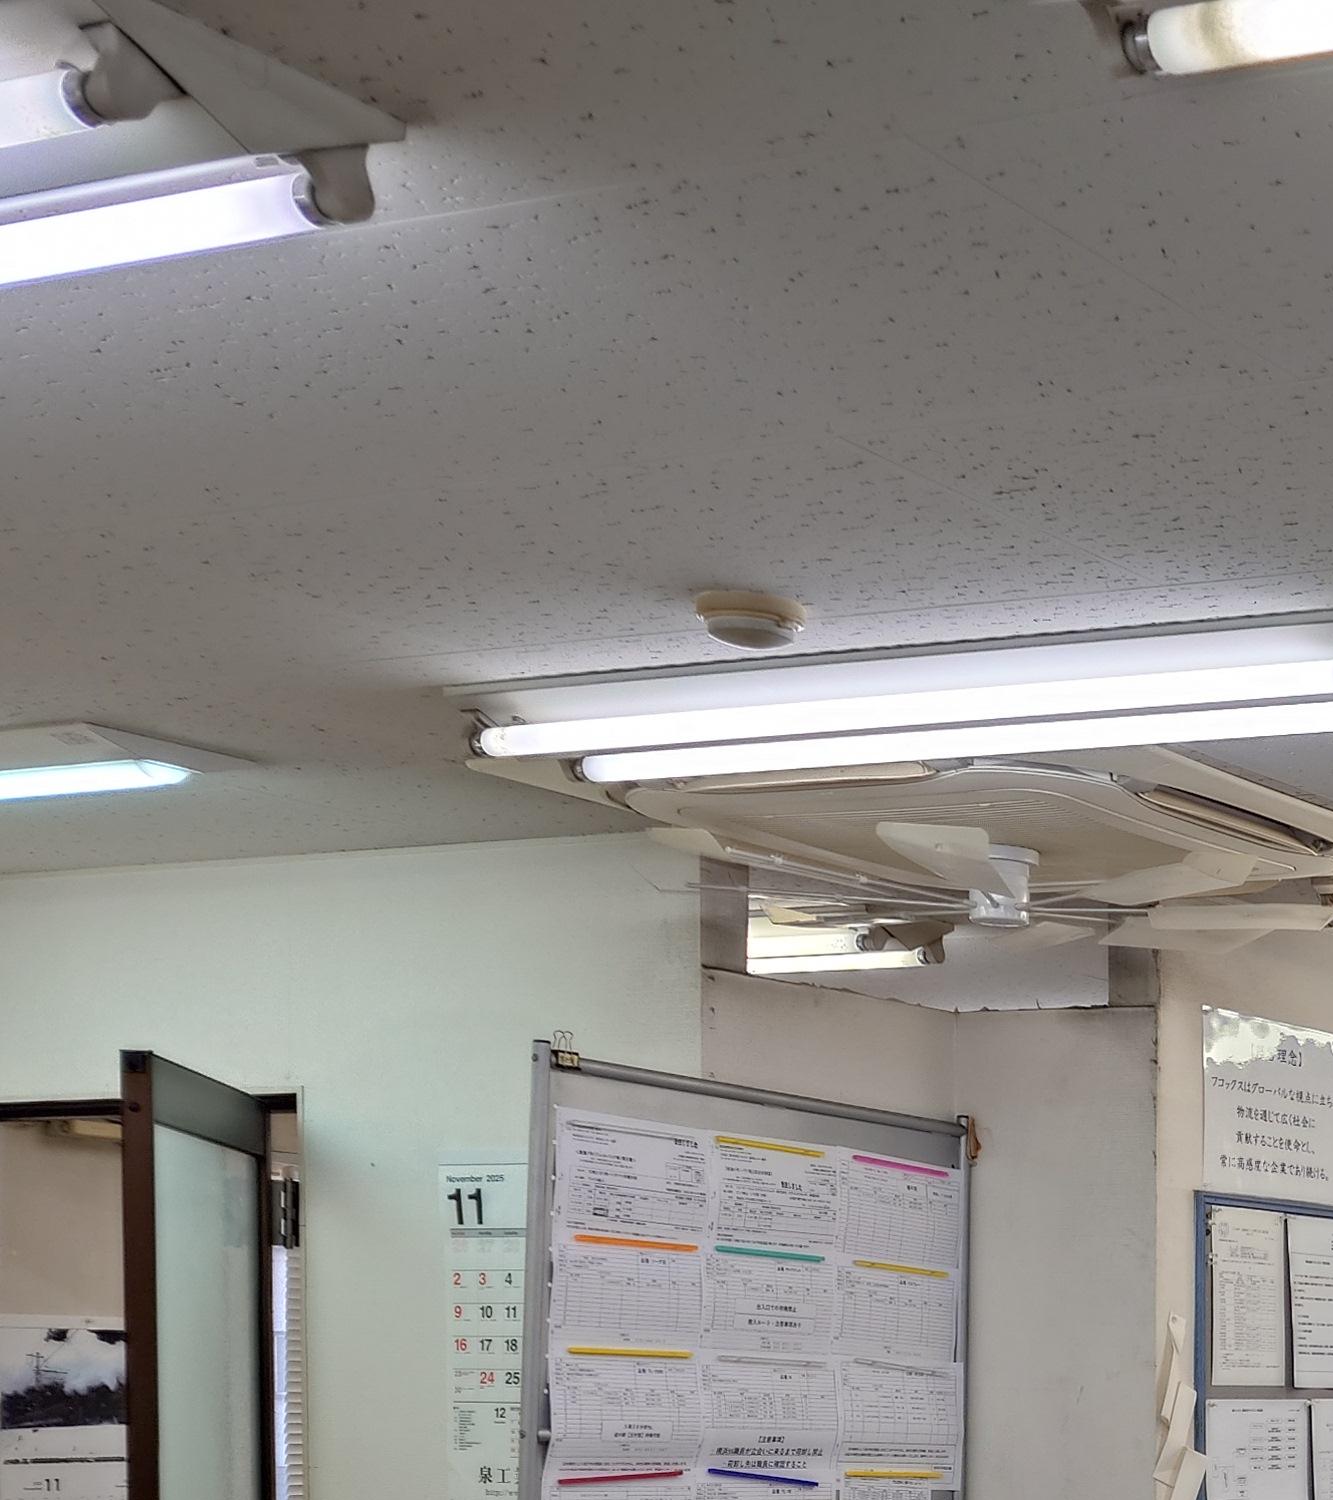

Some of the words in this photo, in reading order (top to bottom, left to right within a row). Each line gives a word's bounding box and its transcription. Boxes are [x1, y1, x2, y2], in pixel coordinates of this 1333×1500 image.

[1236, 1106, 1316, 1128] 物流を通じて広く社会に
[1235, 1131, 1316, 1155] 貢献することを使命とし、
[446, 1175, 483, 1183] November
[486, 1174, 505, 1183] 2025
[447, 1188, 483, 1225] 11
[453, 1272, 461, 1285] 2
[479, 1272, 487, 1285] 3
[505, 1272, 513, 1285] 4
[454, 1306, 462, 1320] 9
[479, 1305, 493, 1320] 10
[504, 1305, 518, 1320] 11
[453, 1339, 467, 1352] 16
[479, 1339, 492, 1352] 17
[504, 1339, 518, 1353] 18
[480, 1371, 495, 1385] 24
[505, 1371, 520, 1385] 25
[494, 1407, 506, 1419] 12
